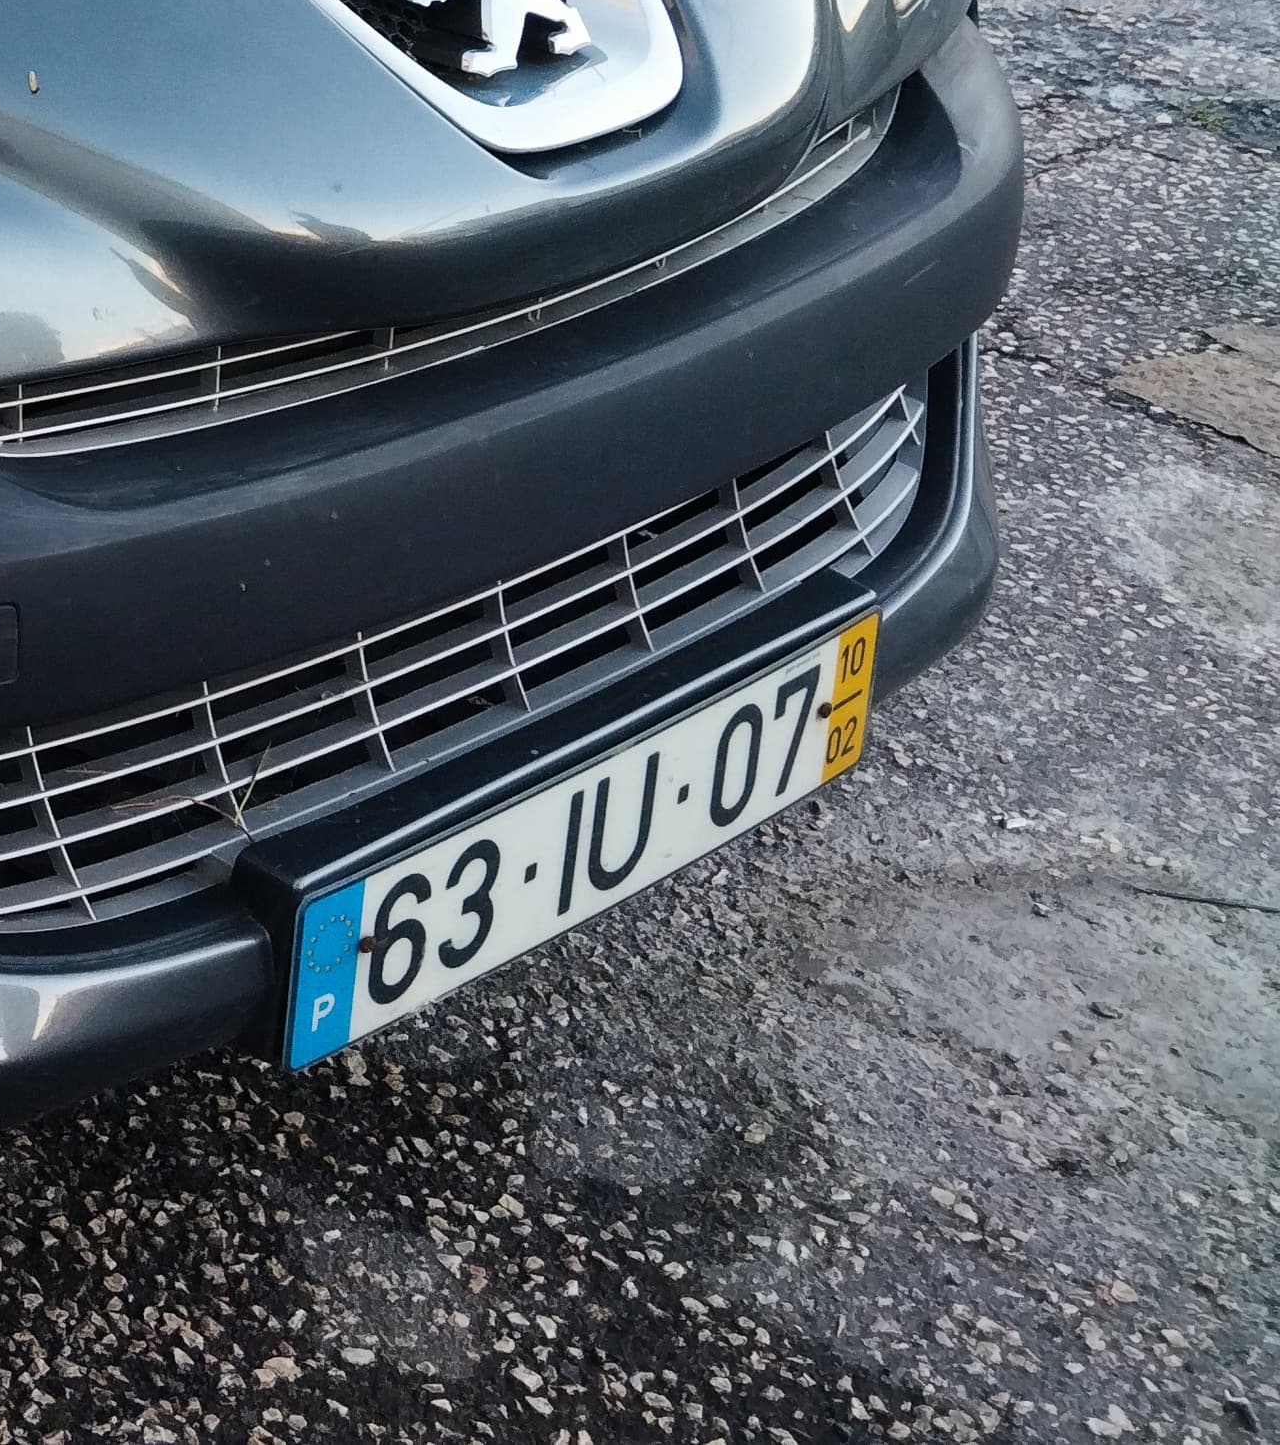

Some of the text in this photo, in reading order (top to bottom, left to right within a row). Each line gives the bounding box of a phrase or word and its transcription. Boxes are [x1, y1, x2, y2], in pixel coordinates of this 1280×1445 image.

[841, 637, 866, 684] 10
[826, 716, 858, 765] 02
[310, 992, 336, 1033] P
